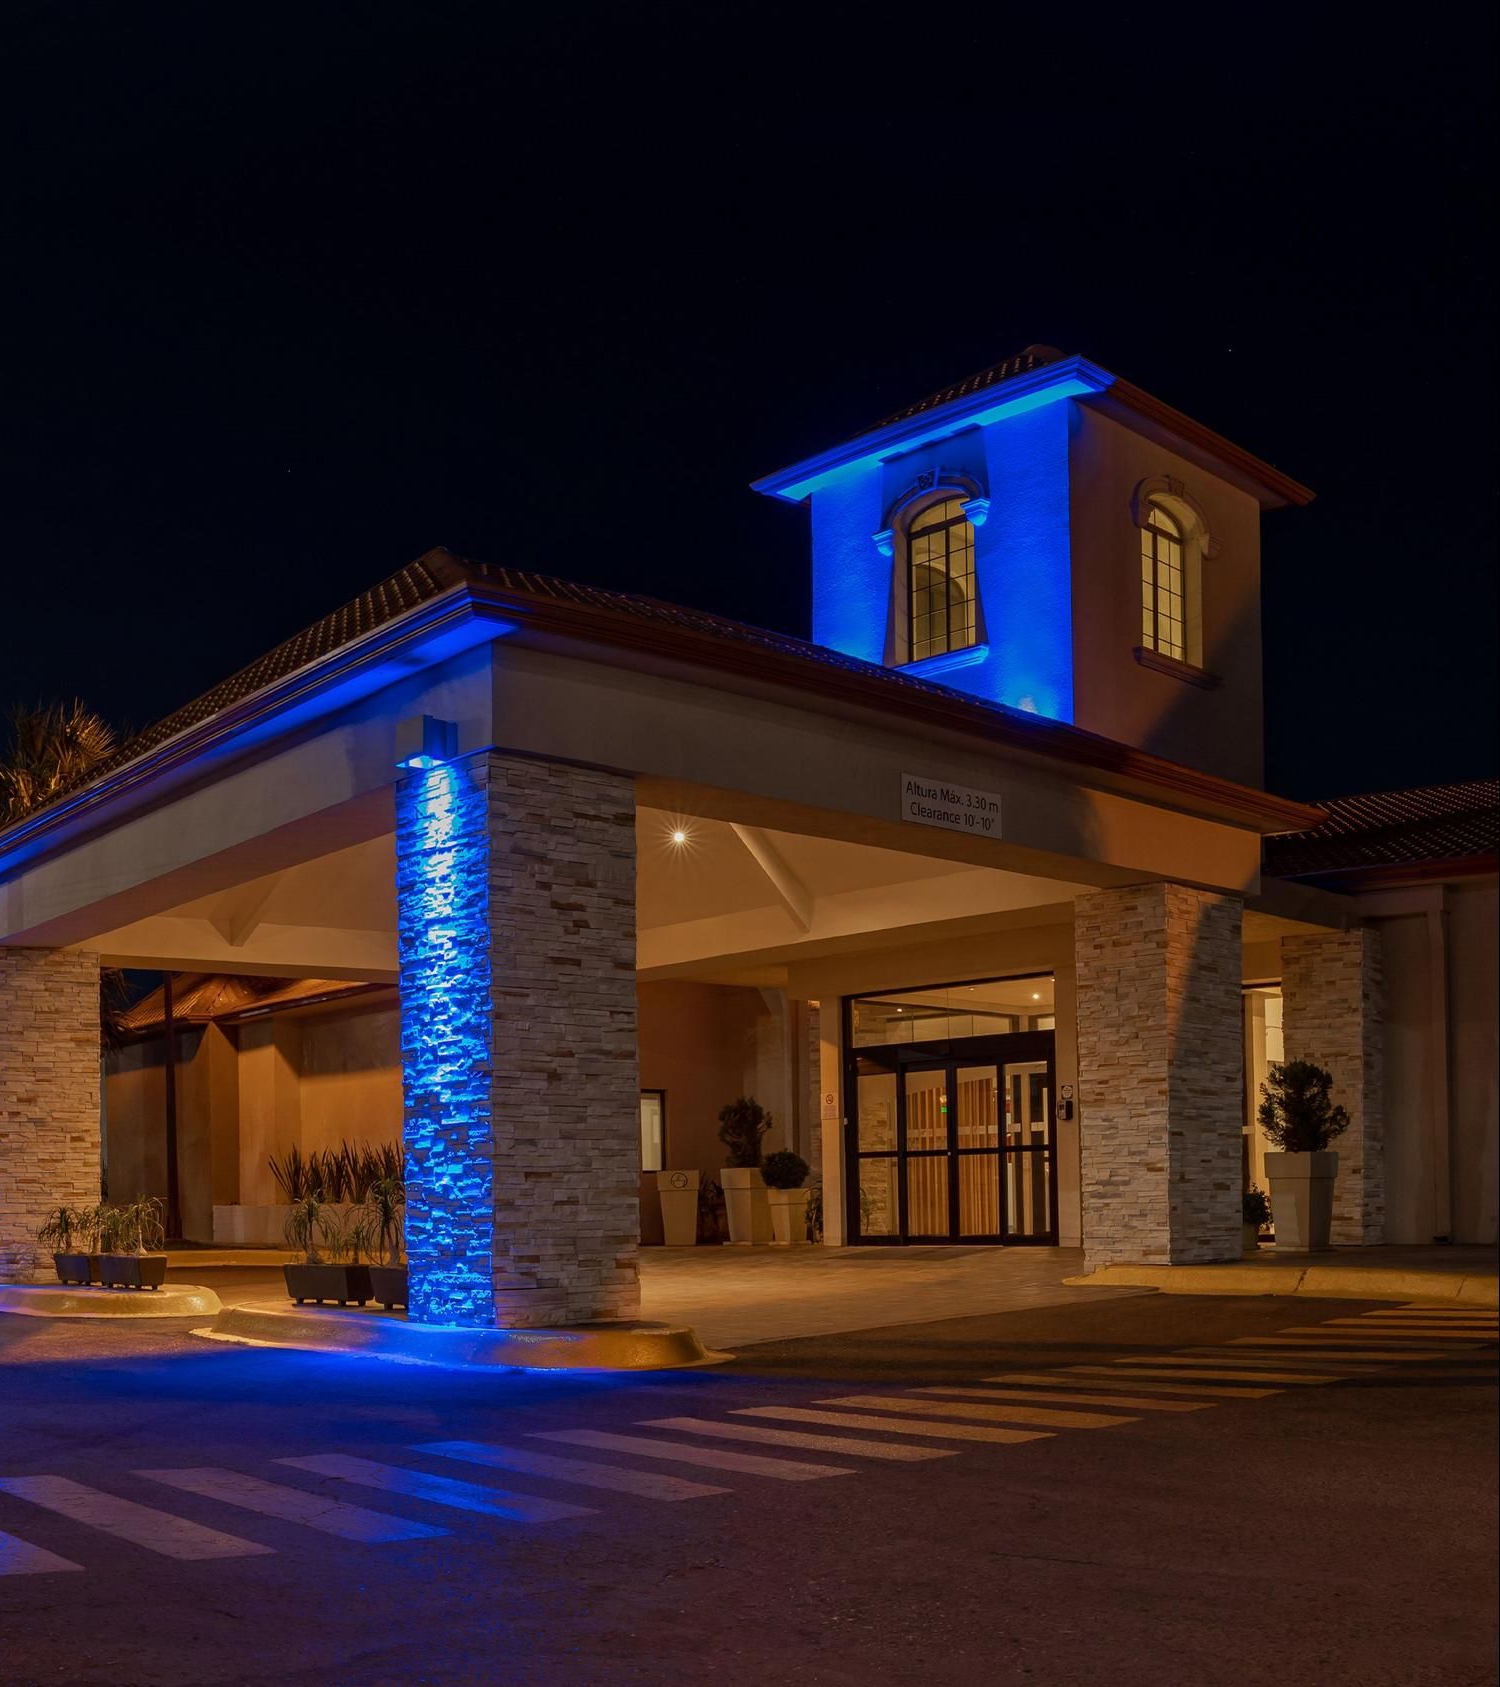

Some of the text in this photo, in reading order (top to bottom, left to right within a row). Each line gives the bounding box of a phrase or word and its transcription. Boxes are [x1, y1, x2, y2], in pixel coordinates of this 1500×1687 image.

[906, 781, 999, 813] Altura Máx. 3.30 m
[910, 801, 961, 825] Clearance
